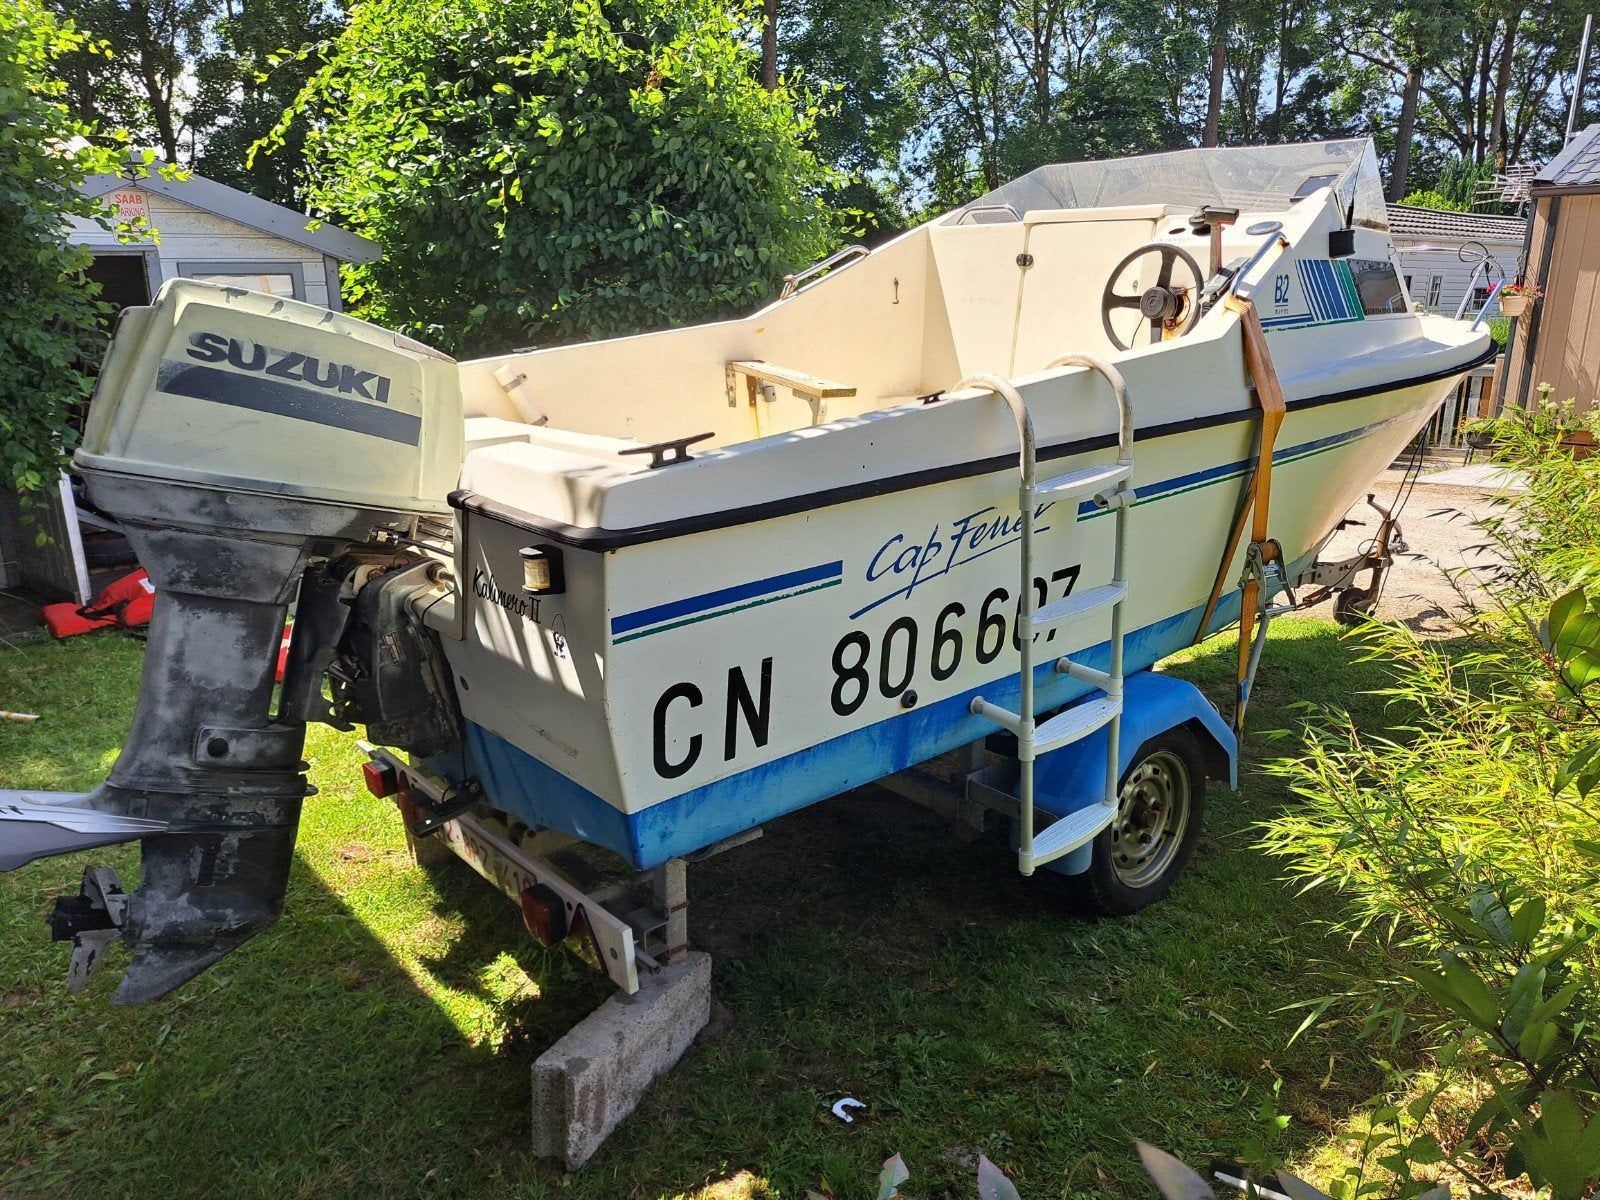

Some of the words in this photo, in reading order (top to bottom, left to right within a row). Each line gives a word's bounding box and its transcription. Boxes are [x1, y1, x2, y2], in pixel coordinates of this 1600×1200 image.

[115, 193, 143, 205] SAAB
[118, 206, 146, 217] ARKING
[1274, 273, 1290, 304] B2
[186, 331, 391, 404] SUZUKI
[866, 523, 943, 600] Cap
[652, 656, 774, 779] CN
